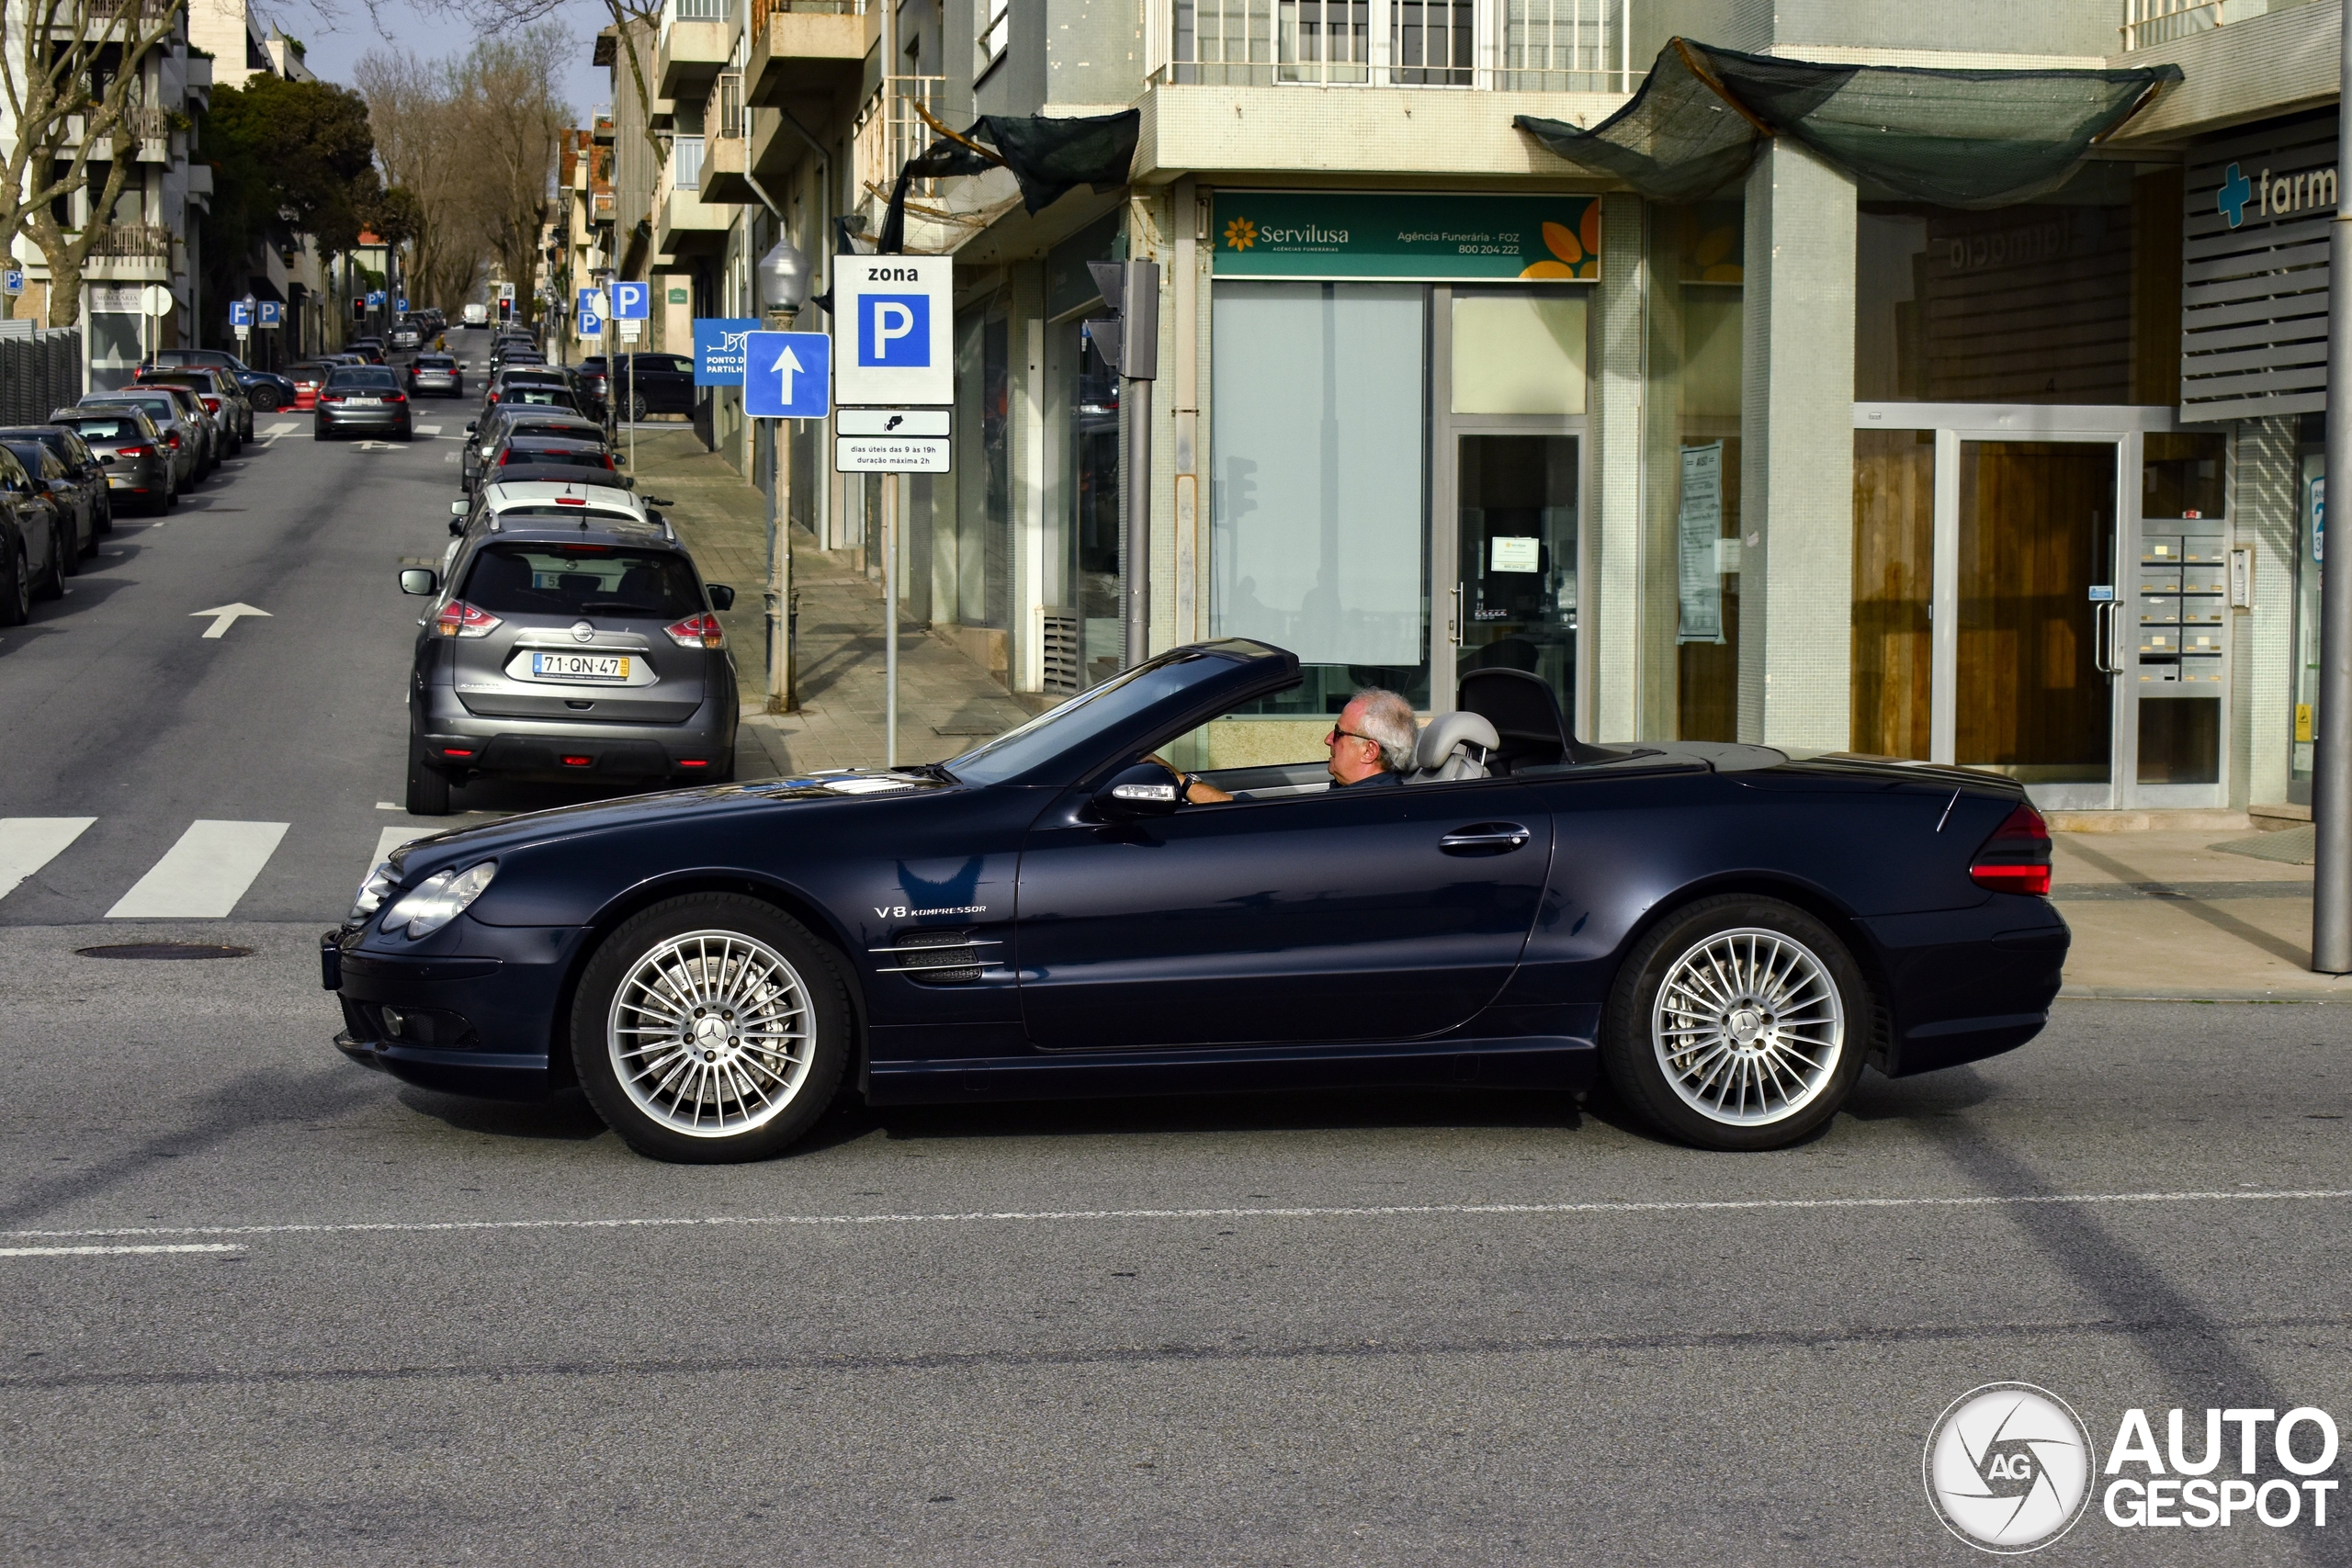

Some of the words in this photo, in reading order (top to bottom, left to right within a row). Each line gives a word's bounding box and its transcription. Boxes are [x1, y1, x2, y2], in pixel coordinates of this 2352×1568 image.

[2260, 168, 2337, 217] farm
[1261, 224, 1349, 243] Servilusa
[1397, 231, 1439, 243] Agência
[1442, 232, 1490, 243] Funerária
[1498, 233, 1520, 243] FOZ
[1458, 244, 1479, 254] 800
[1481, 245, 1499, 254] 204
[1502, 245, 1520, 255] 222
[868, 268, 918, 282] zona
[368, 294, 376, 304] P
[399, 299, 406, 310] P
[619, 287, 640, 315] P
[263, 304, 275, 321] P
[583, 313, 596, 333] P
[874, 302, 914, 359] P
[910, 906, 987, 917] KOMPRESSOR
